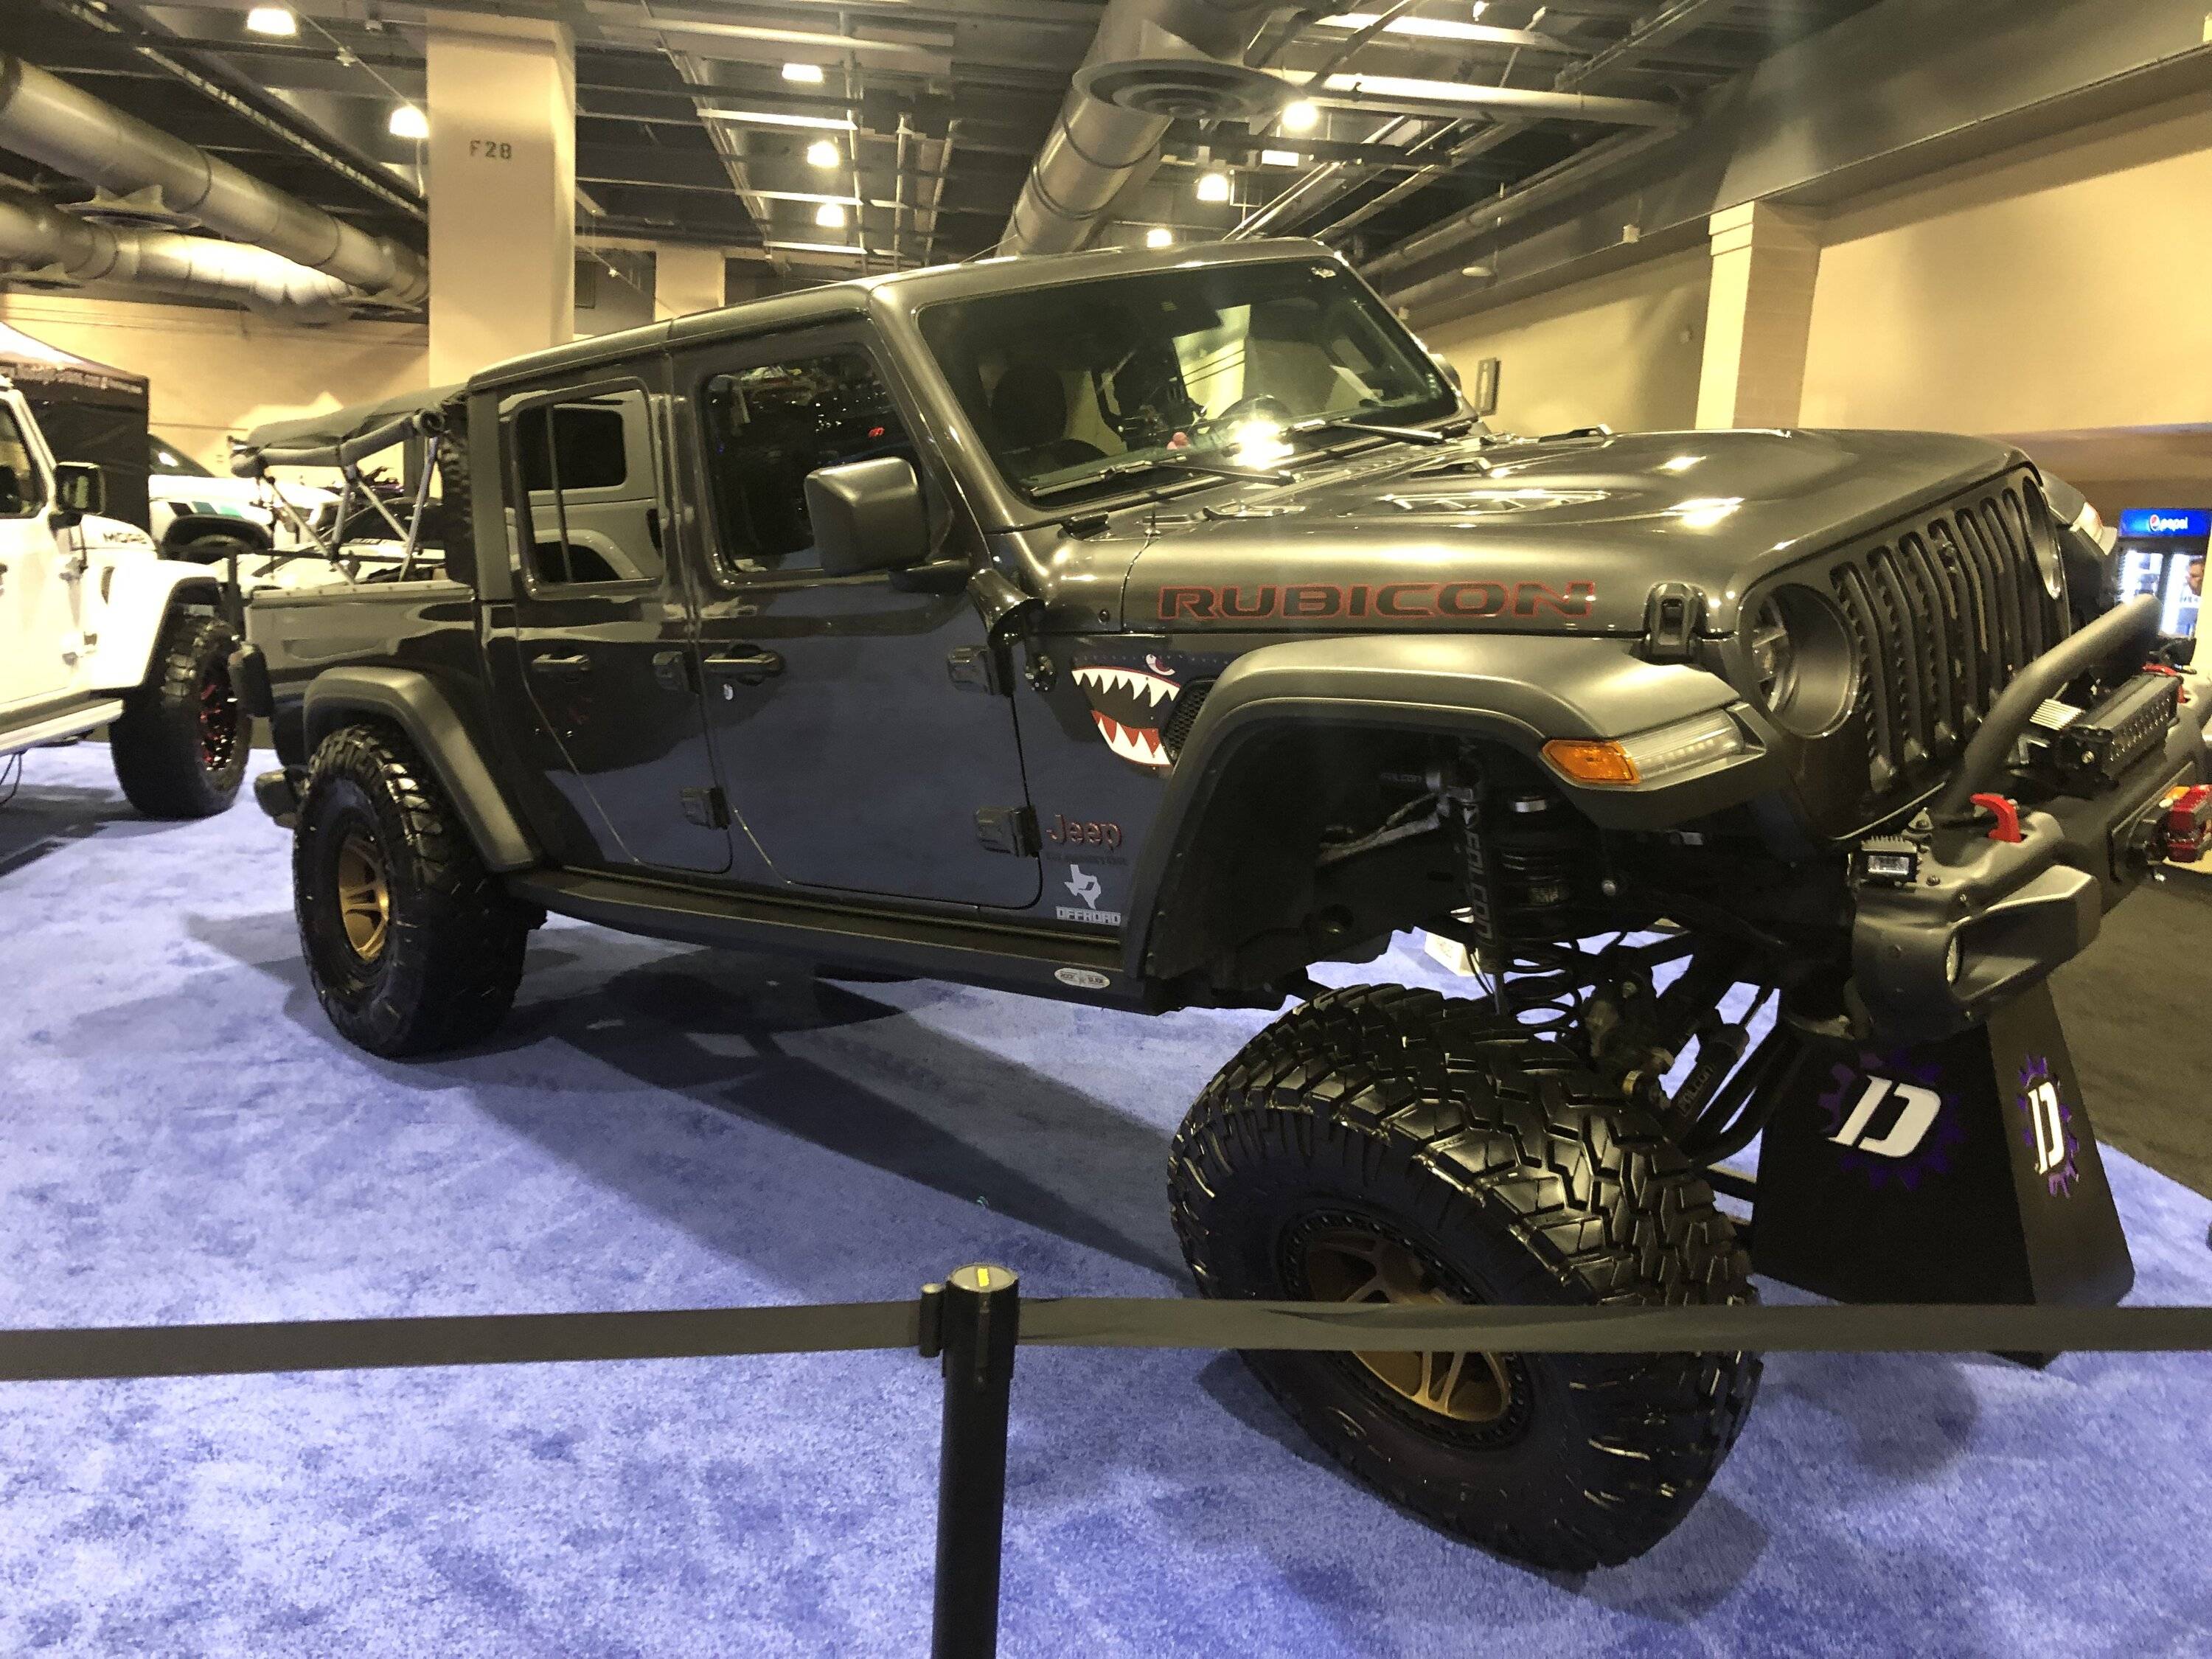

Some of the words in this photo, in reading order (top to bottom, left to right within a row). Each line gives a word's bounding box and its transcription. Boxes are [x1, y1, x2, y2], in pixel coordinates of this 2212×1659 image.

[470, 140, 512, 159] F28
[1158, 581, 1595, 619] RUBICON
[1046, 813, 1121, 852] Jeep
[1056, 906, 1121, 926] OFFROAD
